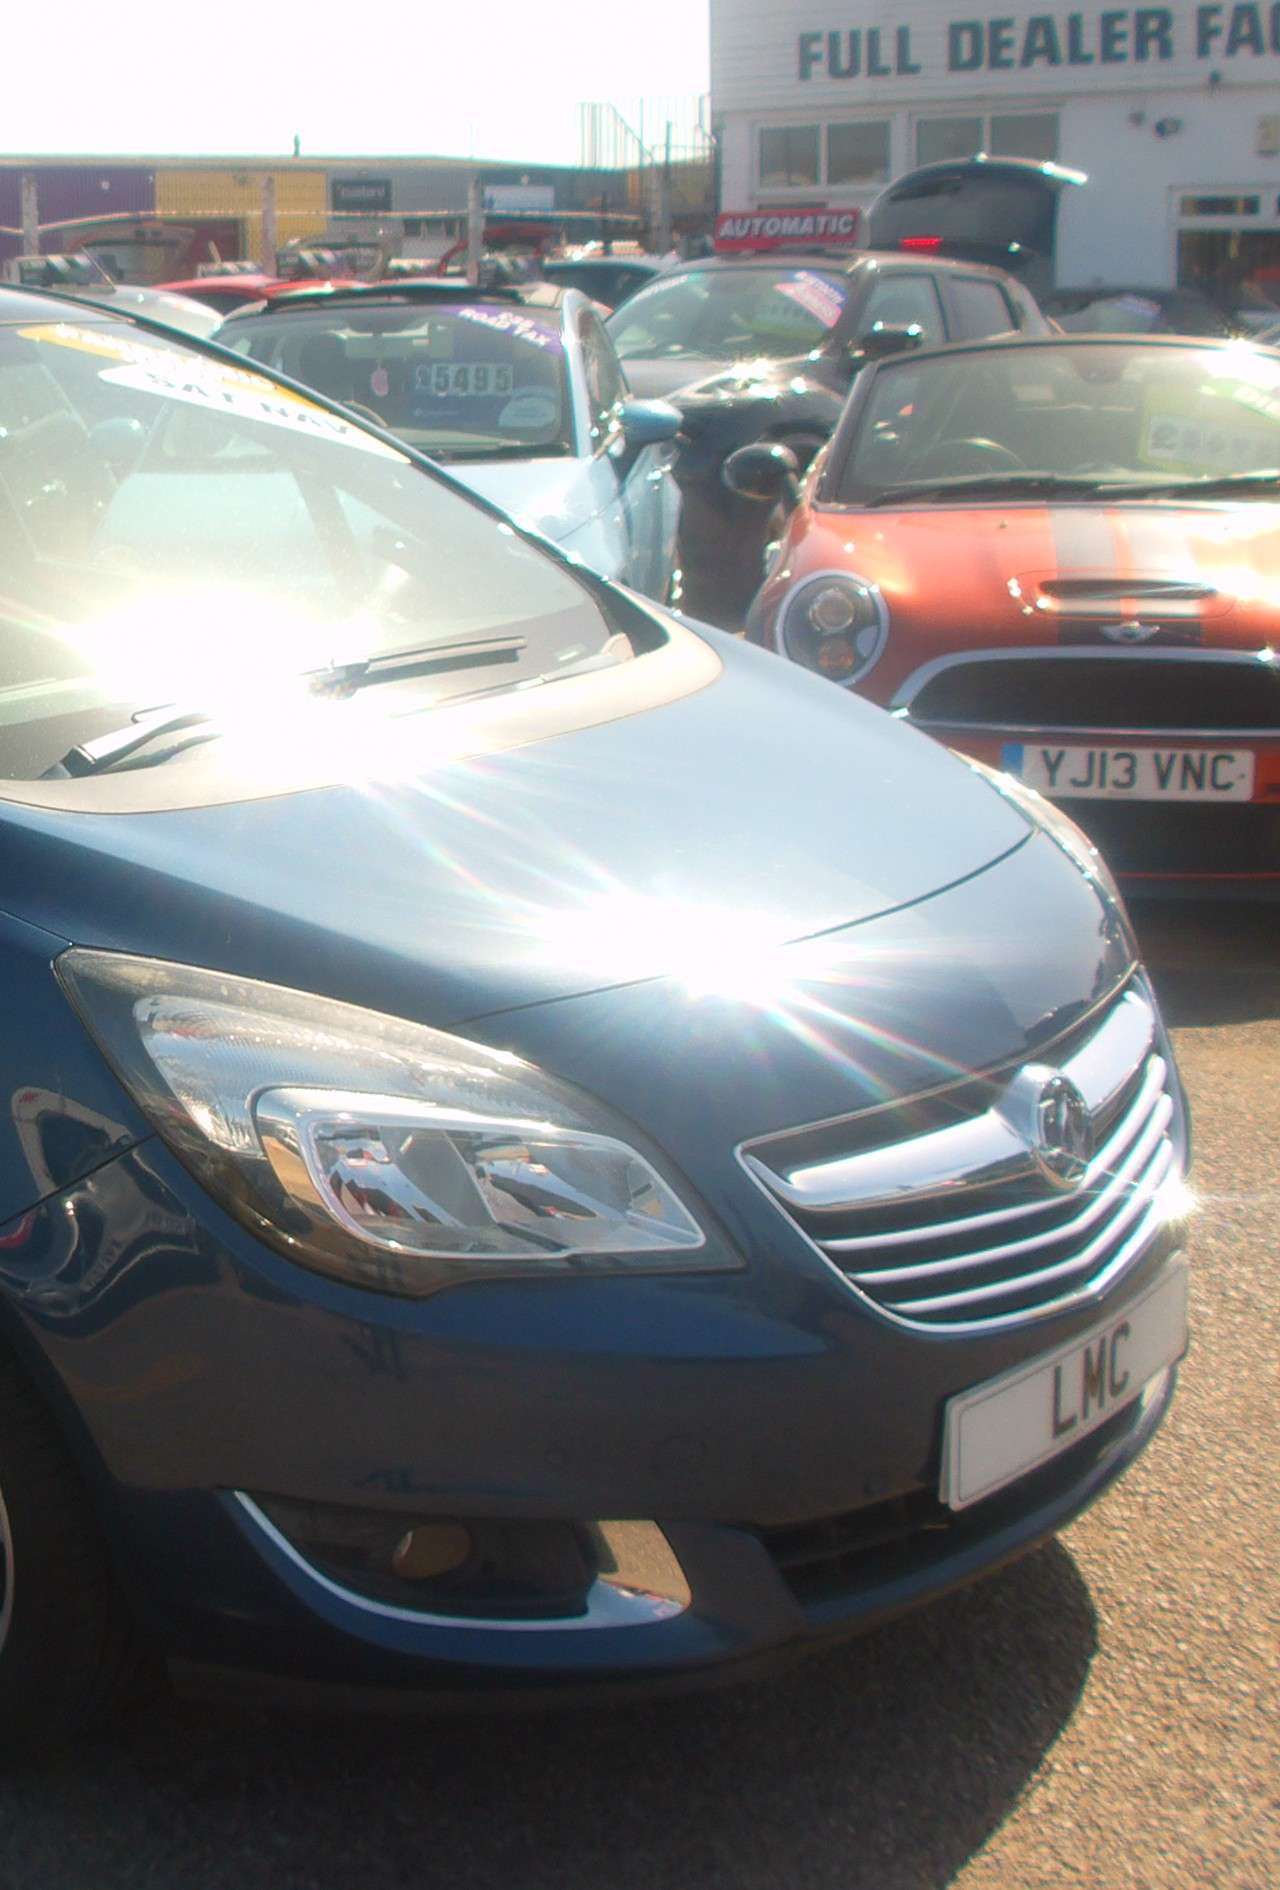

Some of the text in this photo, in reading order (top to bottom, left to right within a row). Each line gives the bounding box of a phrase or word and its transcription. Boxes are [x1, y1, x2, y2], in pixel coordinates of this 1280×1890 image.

[798, 24, 921, 81] FULL
[947, 7, 1175, 72] DEALER
[720, 214, 854, 238] AUTOMATIC
[1041, 749, 1236, 791] YJ13 VNC
[1050, 1321, 1130, 1440] LMC
